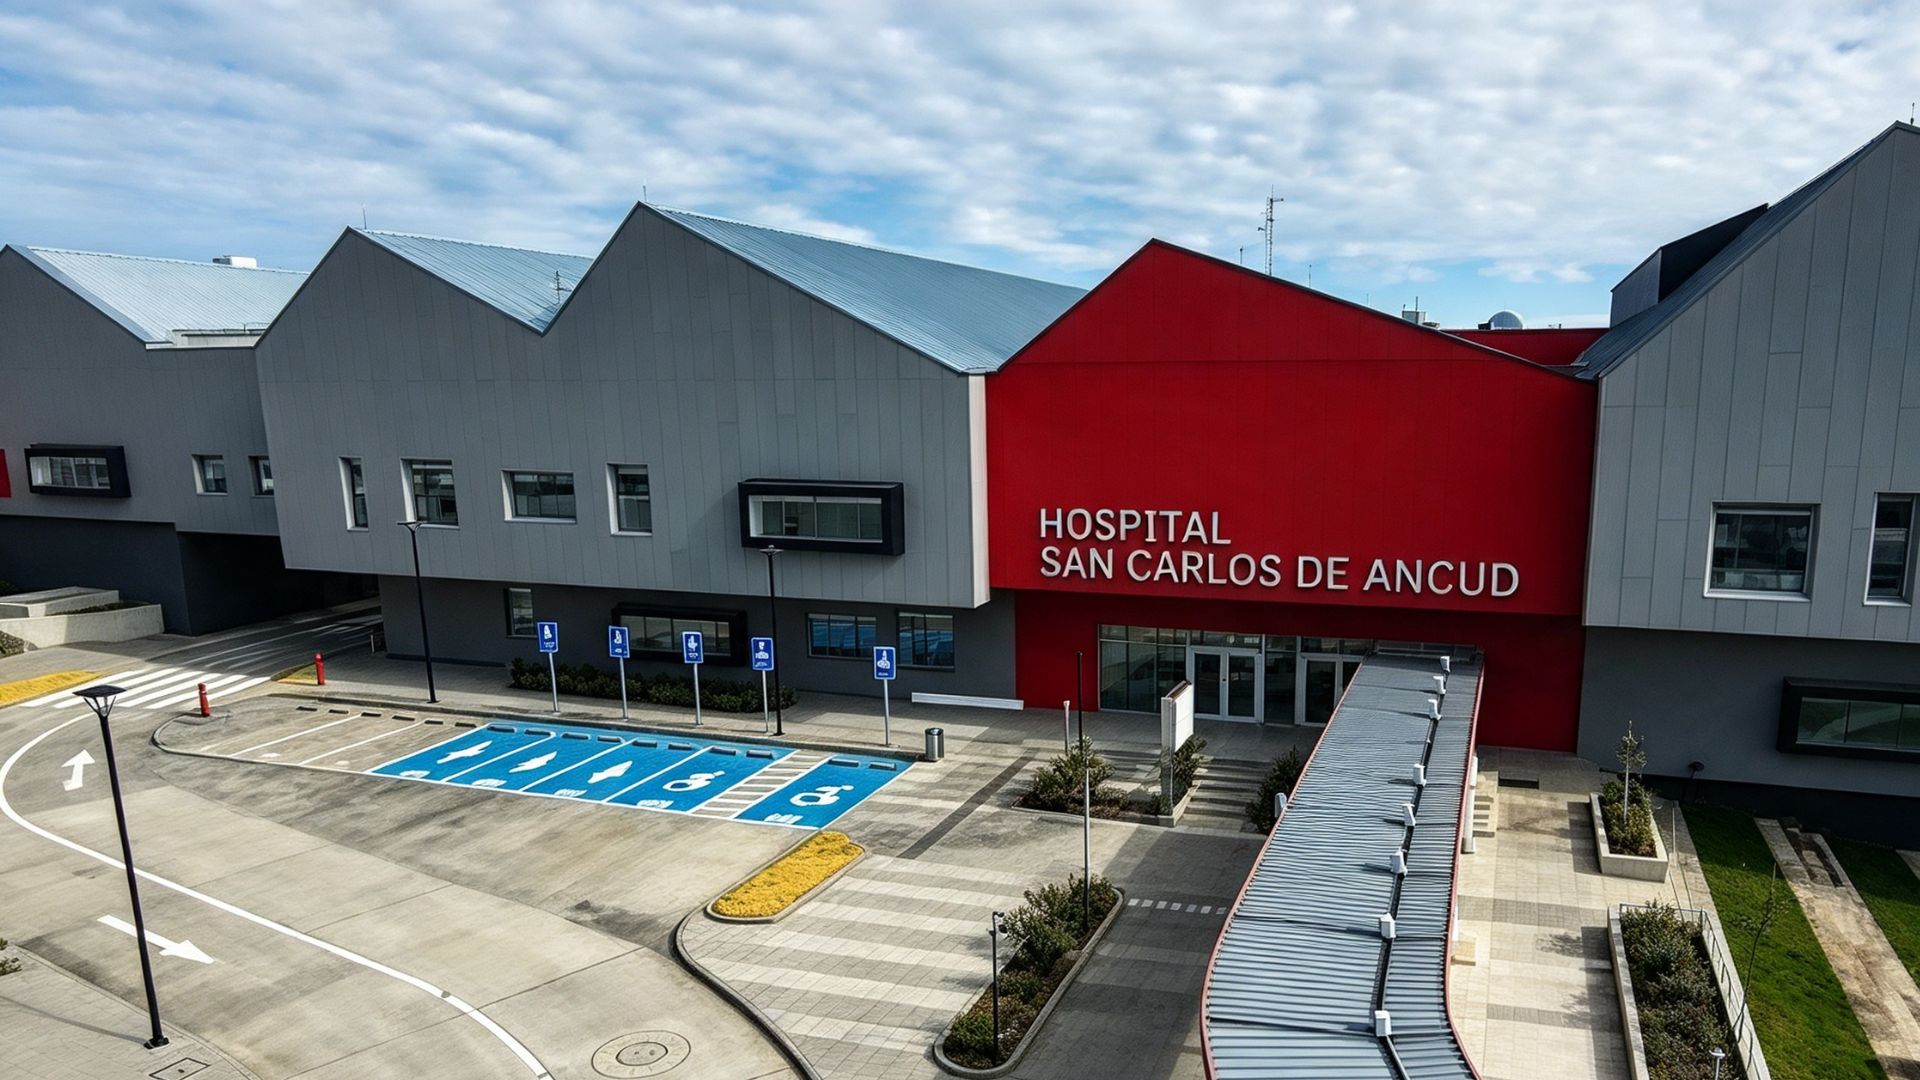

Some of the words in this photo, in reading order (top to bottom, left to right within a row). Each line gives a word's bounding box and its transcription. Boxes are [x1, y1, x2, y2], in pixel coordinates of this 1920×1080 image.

[1039, 507, 1232, 545] HOSPITAL
[1040, 545, 1114, 580] SAN
[1126, 549, 1282, 587] CARLOS
[1297, 556, 1350, 590] DE
[1362, 558, 1520, 597] ANCUD
